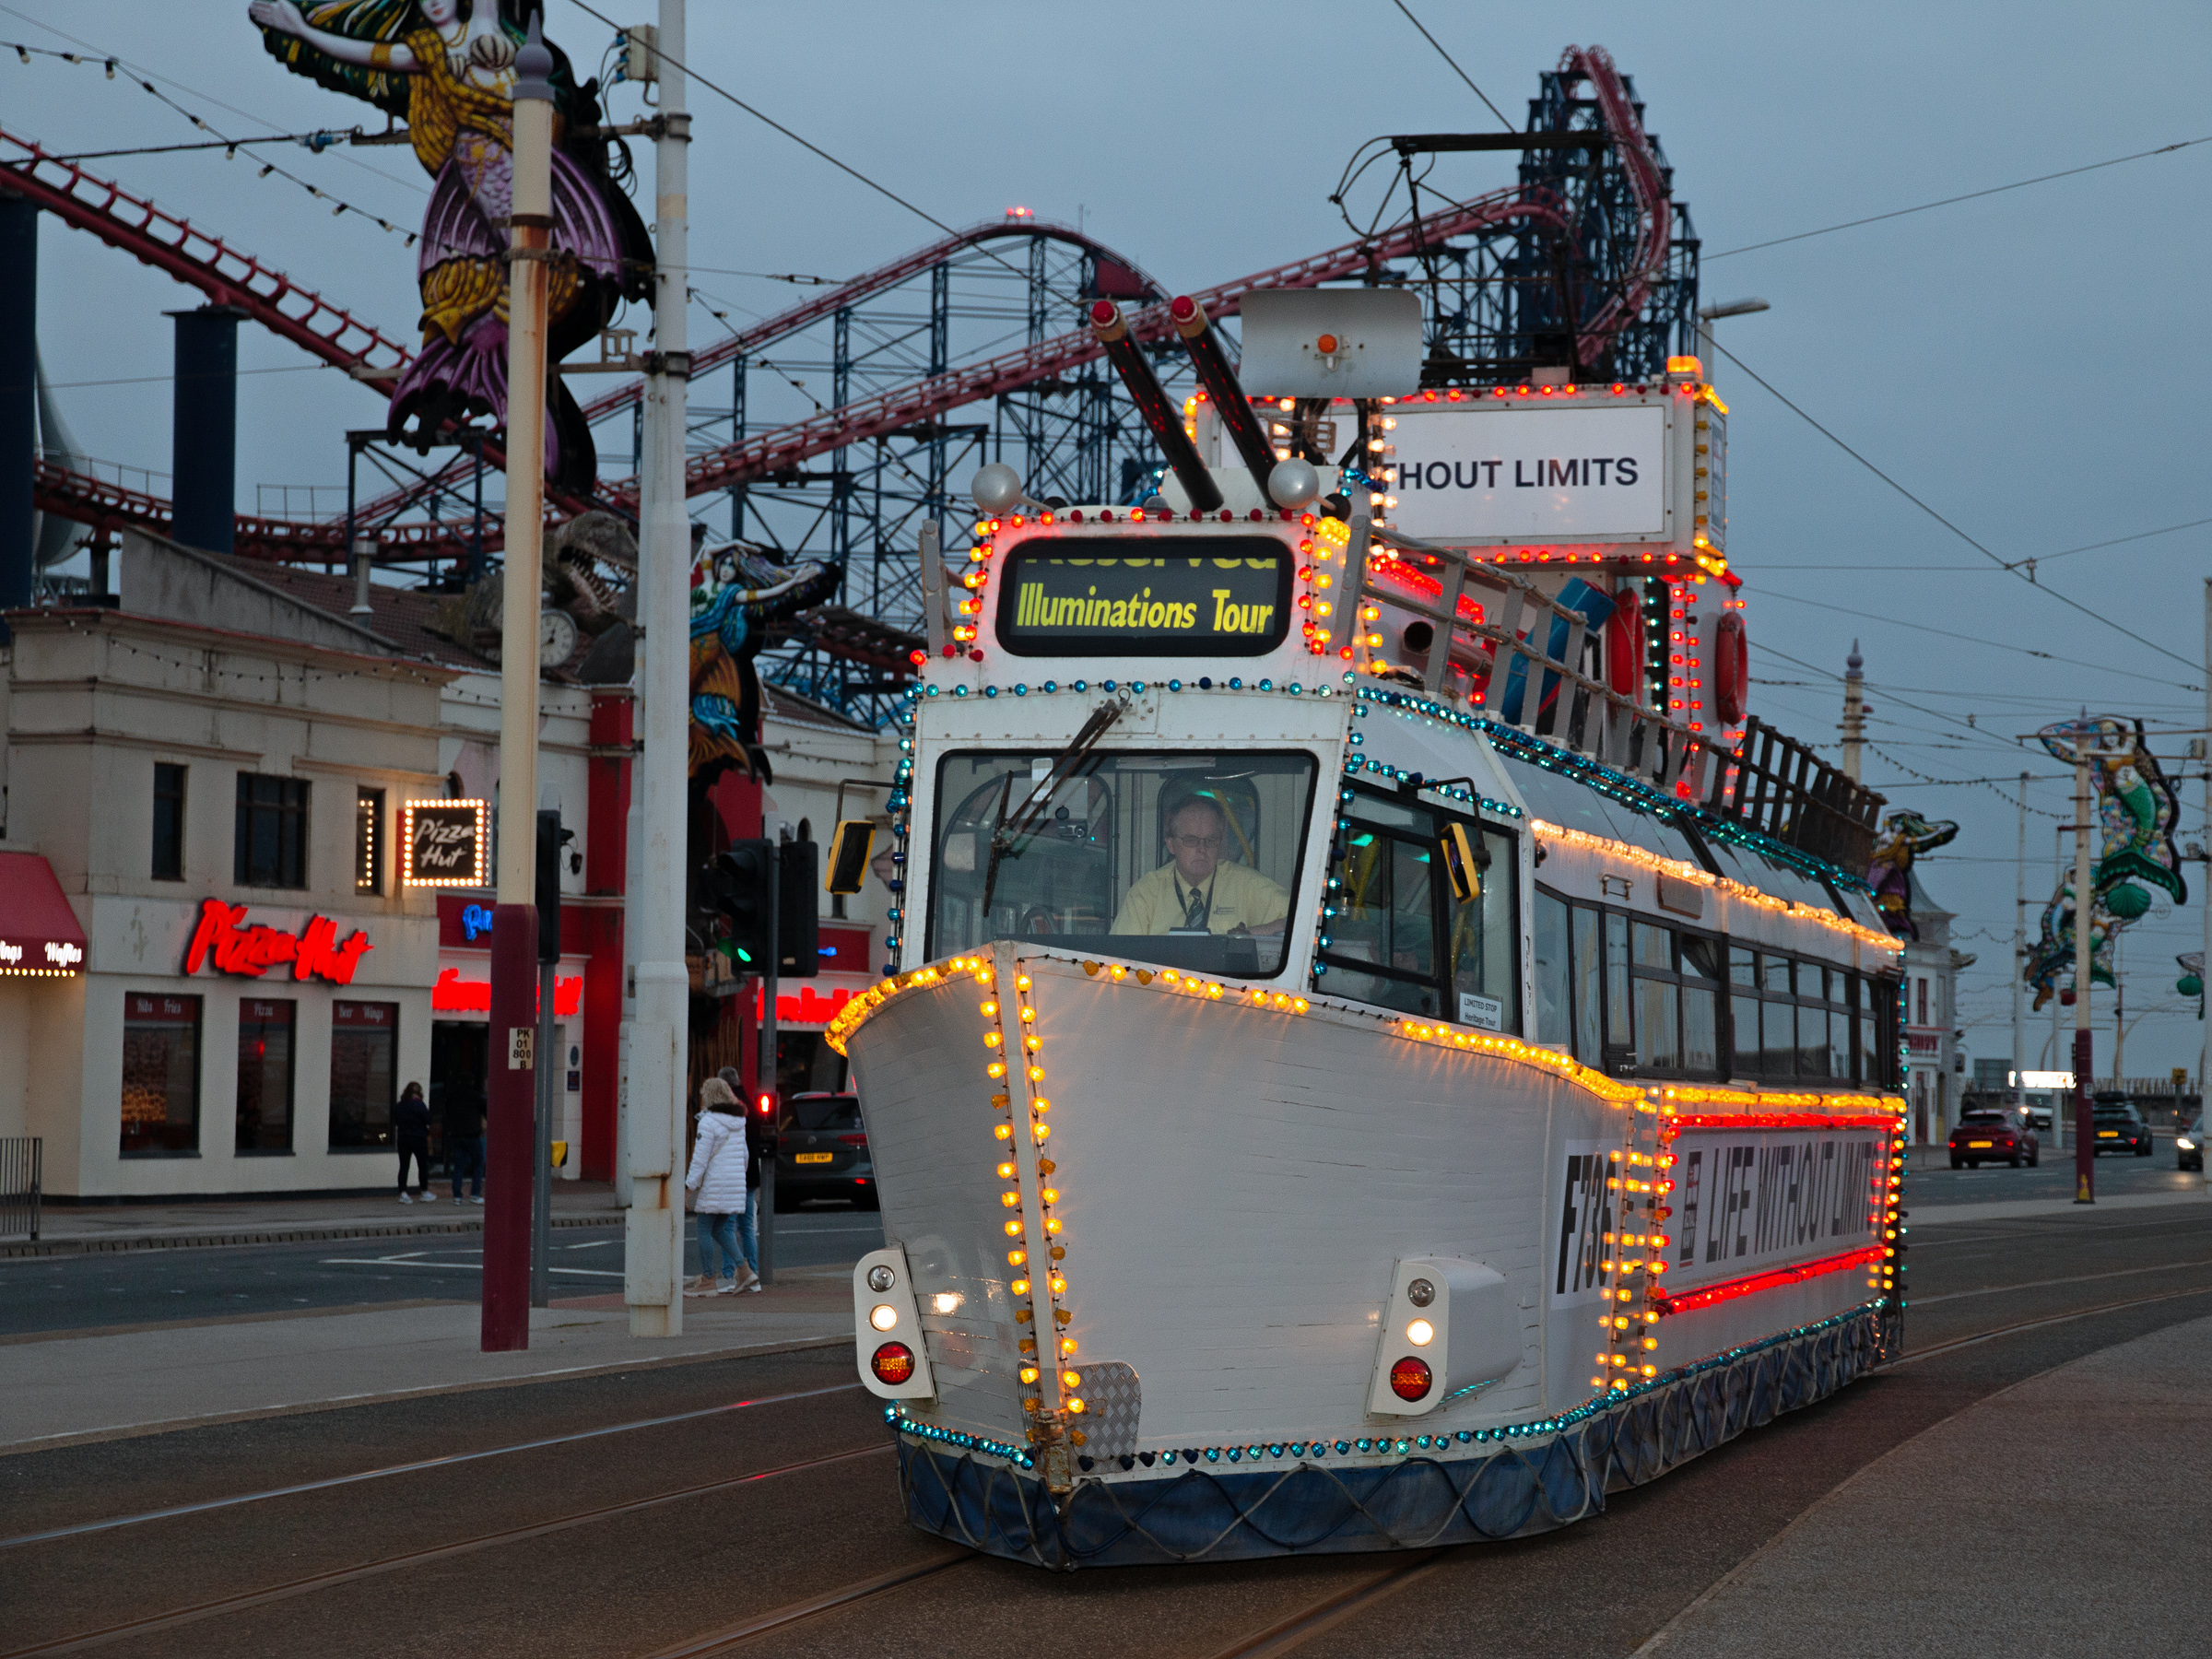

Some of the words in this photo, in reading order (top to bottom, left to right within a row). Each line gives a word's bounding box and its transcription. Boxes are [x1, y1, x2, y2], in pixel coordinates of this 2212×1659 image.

[1514, 457, 1639, 488] LIMITS
[1017, 582, 1197, 629] Illuminations
[1212, 589, 1274, 633] Tour
[413, 818, 476, 845] Pizza
[420, 843, 467, 868] Hut
[186, 899, 298, 977] Pizza
[294, 915, 374, 984] Hut
[44, 942, 82, 968] Waffles
[1464, 997, 1485, 1010] LIMITED
[1485, 1003, 1498, 1013] STOP
[516, 1040, 527, 1049] 01
[517, 1029, 530, 1038] PK
[512, 1049, 531, 1059] 800
[520, 1061, 527, 1069] B
[1706, 1146, 1755, 1263] LIFE
[1754, 1141, 1834, 1255] WITHOUT
[1557, 1154, 1617, 1294] F736
